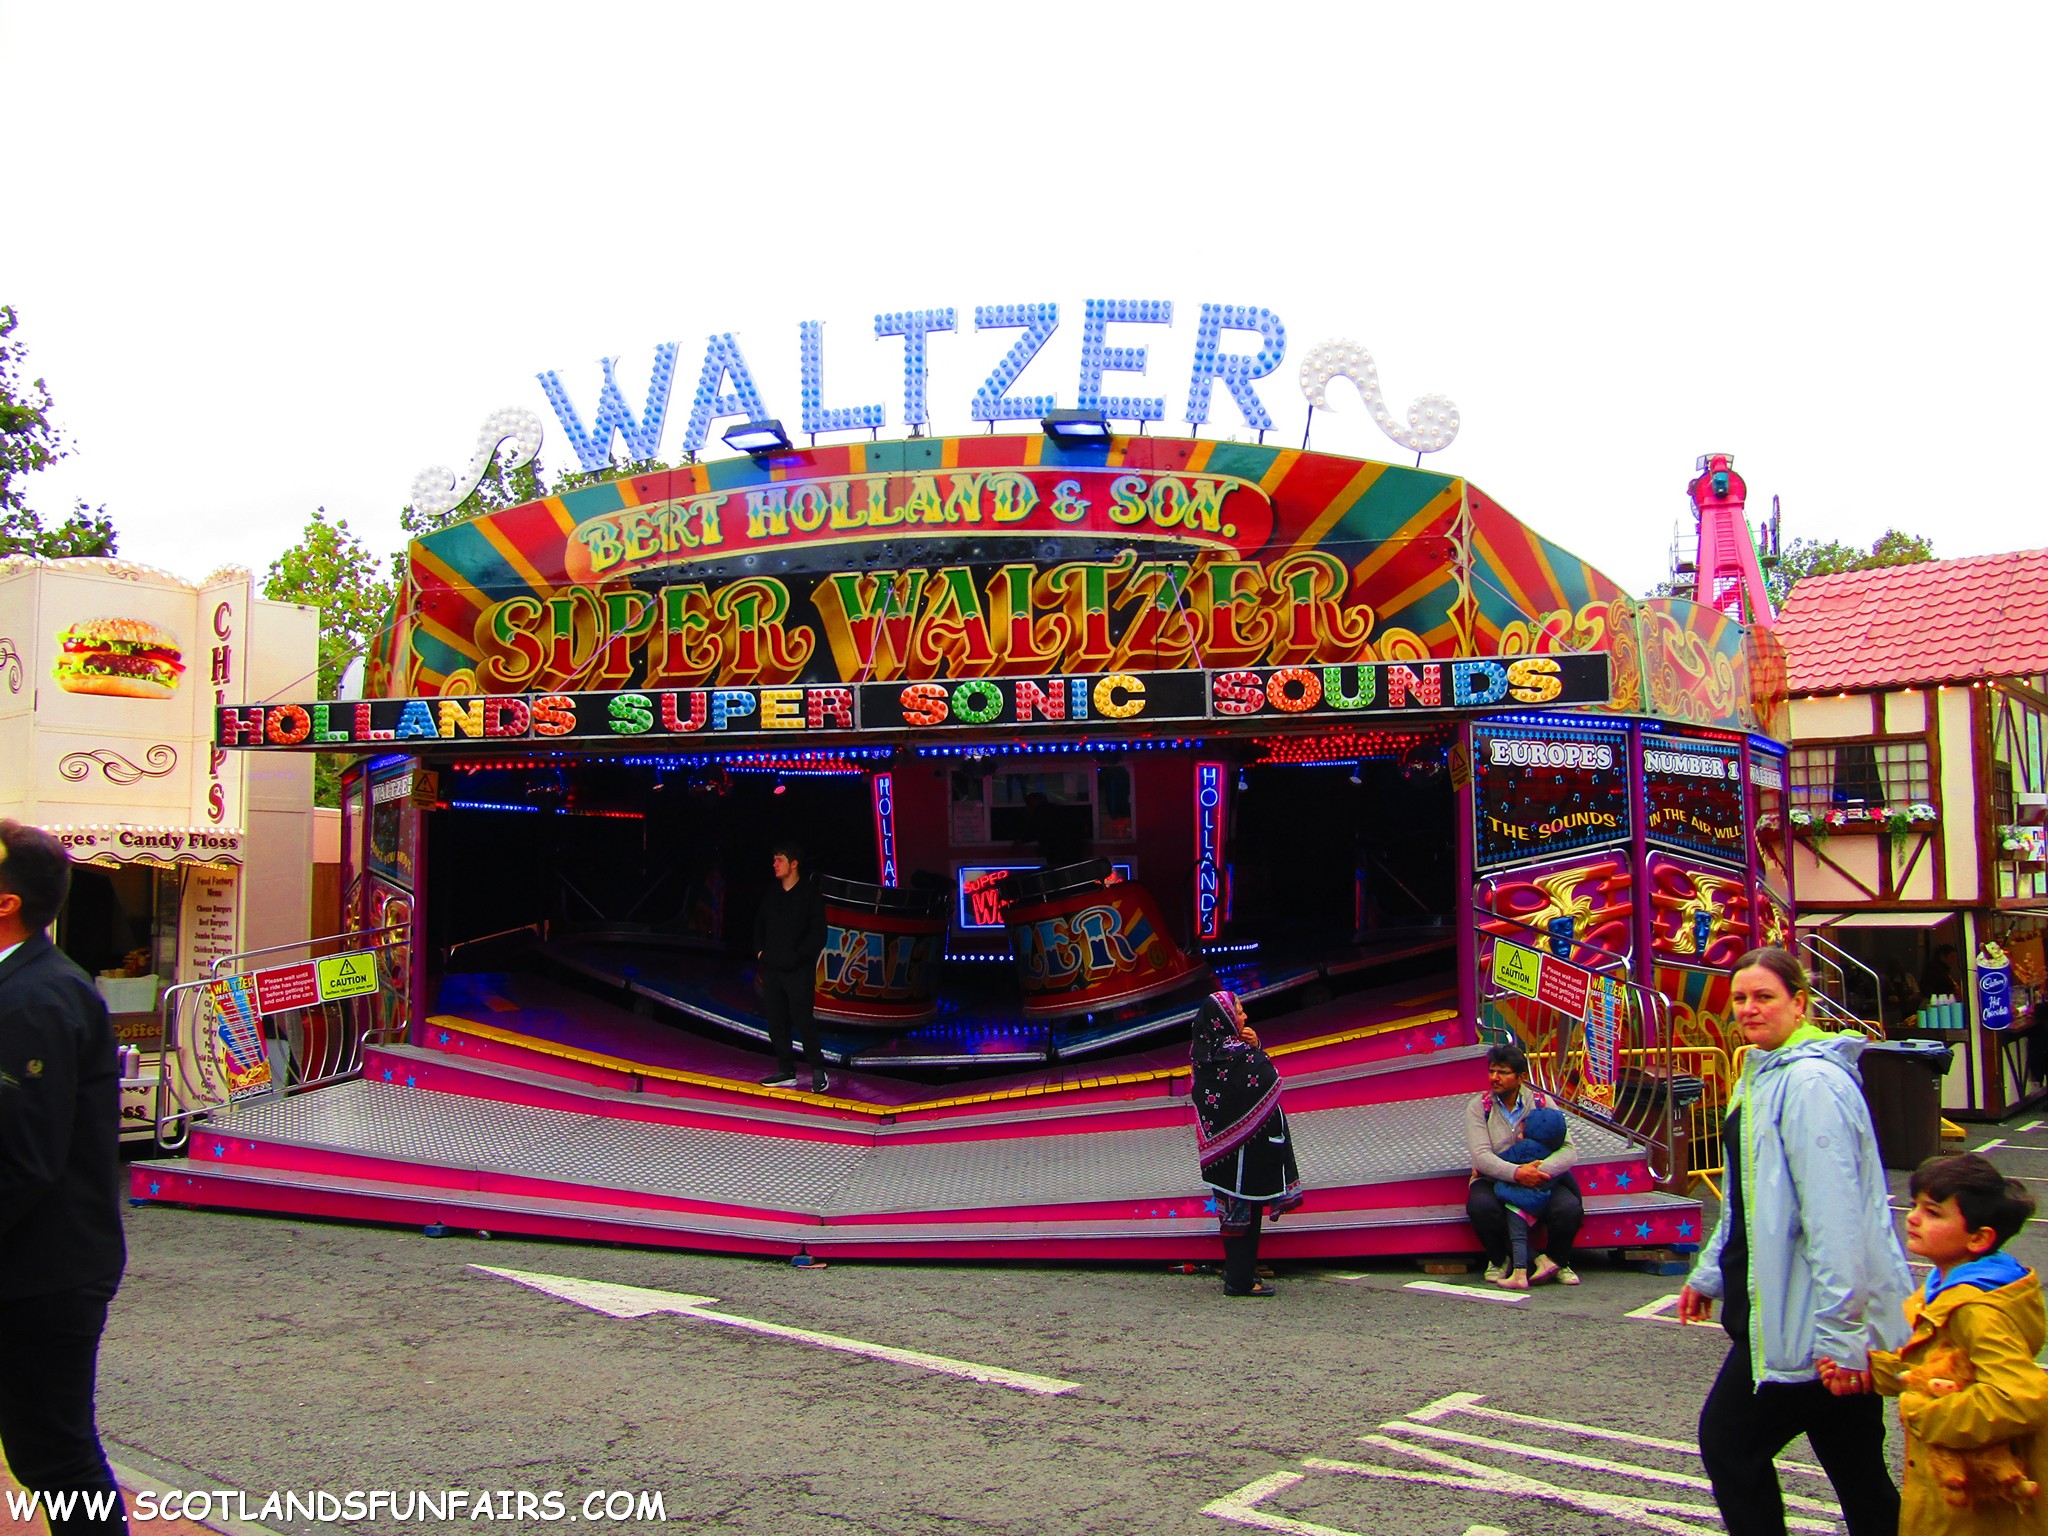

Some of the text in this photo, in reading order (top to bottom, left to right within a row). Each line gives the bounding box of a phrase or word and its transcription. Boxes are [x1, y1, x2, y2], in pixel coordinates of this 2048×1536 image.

[534, 298, 1287, 472] WALTZER
[579, 473, 1239, 573] BERT HOLLAND & SON.
[482, 549, 1374, 687] SUPER WALTZER
[221, 658, 1562, 745] HOLLANDS SUPER SONIC SOUNDS
[1490, 739, 1612, 769] EUROPES
[1644, 750, 1739, 780] NUMBER 1
[1488, 812, 1617, 840] THE SOUNDS
[1649, 808, 1741, 838] IN THE AIR WILL
[119, 831, 184, 850] Candy
[188, 833, 239, 850] Floss
[264, 977, 283, 985] Please
[296, 971, 309, 979] until
[292, 977, 315, 988] stopped
[330, 974, 367, 988] CAUTION
[1501, 966, 1530, 984] CAUTION
[1547, 966, 1582, 986] Please wait until
[1550, 974, 1558, 983] ride
[1558, 979, 1566, 987] has
[1567, 982, 1585, 995] stopped
[213, 978, 255, 994] WALTZER
[215, 991, 235, 1001] SAFETY
[266, 990, 284, 998] before
[285, 987, 304, 996] getting
[1545, 981, 1558, 991] before
[1559, 987, 1575, 999] getting
[1592, 977, 1623, 999] WALTZER
[1542, 987, 1550, 995] and
[1571, 1000, 1581, 1009] cars
